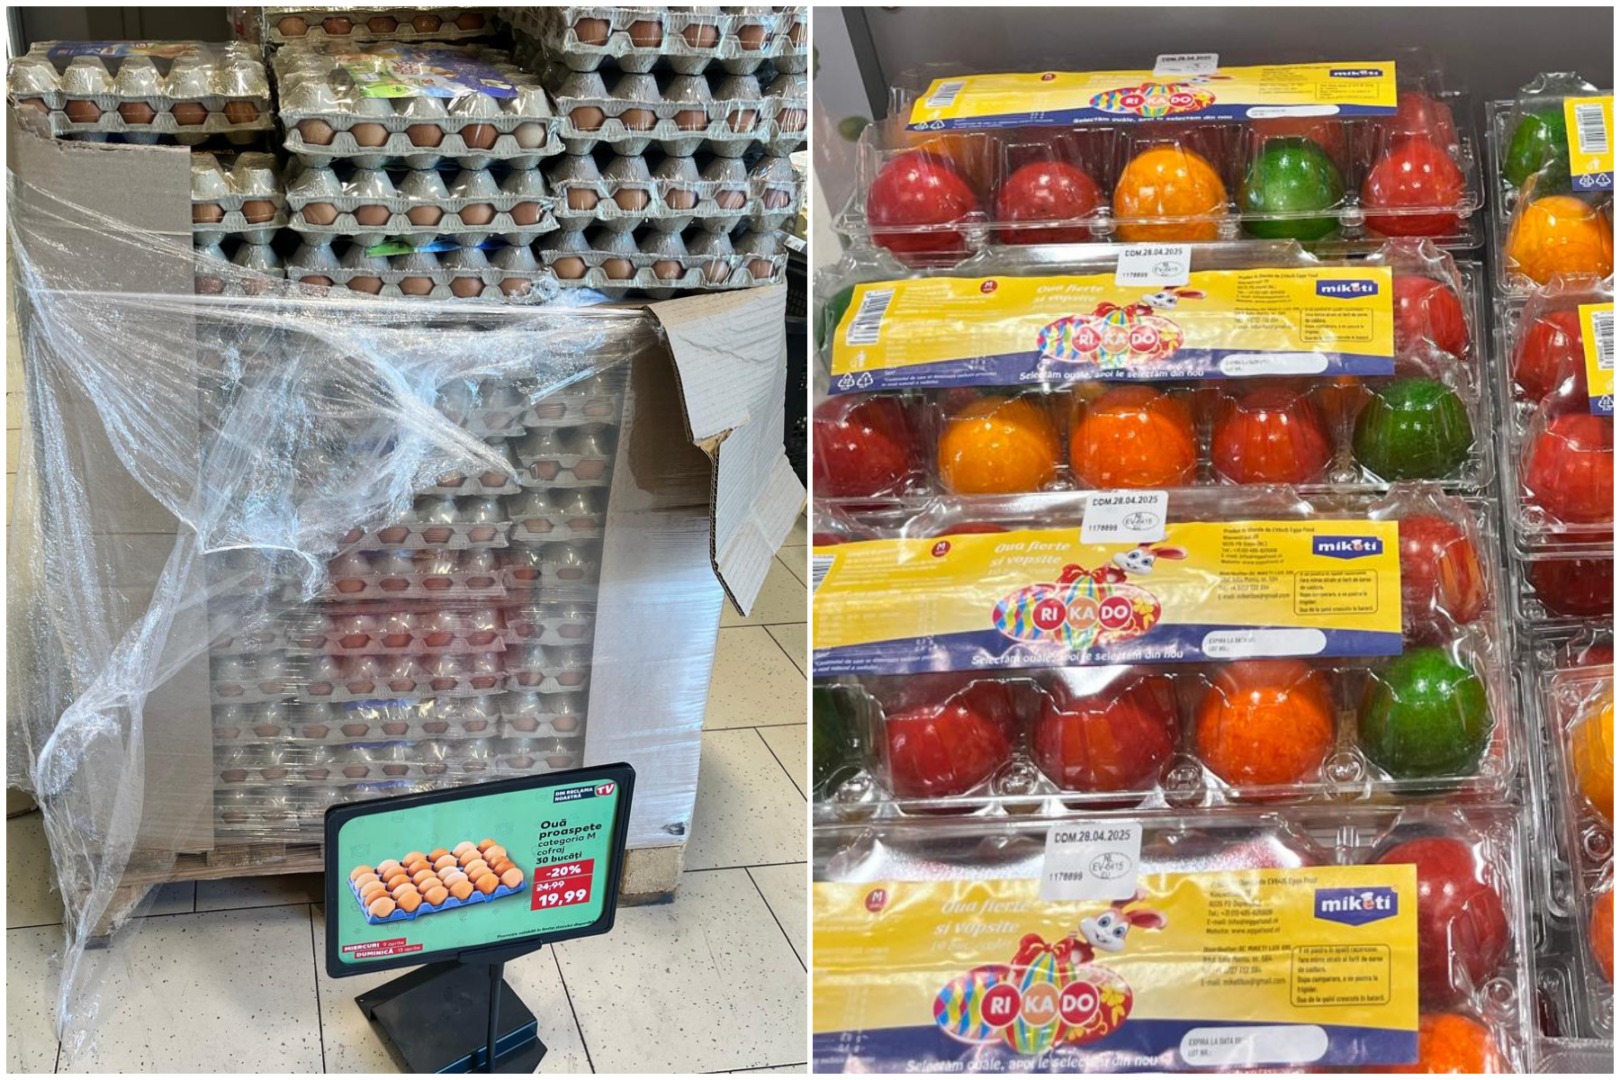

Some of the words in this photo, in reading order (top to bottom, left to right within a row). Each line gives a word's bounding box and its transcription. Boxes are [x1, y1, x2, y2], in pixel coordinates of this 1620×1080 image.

[1079, 334, 1095, 346] RI
[1131, 333, 1156, 344] DO
[1092, 495, 1158, 507] DDM.28.04.2025
[935, 541, 946, 550] M
[1025, 540, 1072, 553] fierte
[1317, 540, 1377, 552] miketi
[1041, 608, 1058, 621] RI
[1069, 605, 1095, 620] KA
[1101, 605, 1128, 619] DO
[566, 787, 594, 796] RECLAMA
[596, 782, 615, 795] TV
[541, 818, 568, 829] Ouă
[539, 823, 602, 841] proaspete
[1054, 829, 1131, 843] DDM.28.04.2025
[538, 834, 585, 848] categoria
[587, 832, 597, 840] M
[536, 845, 566, 857] cofraj
[535, 857, 549, 865] 30
[546, 863, 582, 878] -20%
[1048, 871, 1083, 881] 1178899
[536, 880, 565, 892] 24,99
[538, 888, 587, 907] 19,99
[871, 890, 884, 902] M
[1321, 893, 1392, 912] miketi
[955, 920, 1020, 938] vopsite
[344, 942, 380, 951] MIERCURI
[356, 948, 394, 958] DUMINICĂ
[990, 997, 1010, 1014] RI
[1024, 996, 1054, 1013] KA
[1062, 995, 1094, 1012] DO
[1037, 1055, 1049, 1069] le
[1134, 1056, 1159, 1067] nou
